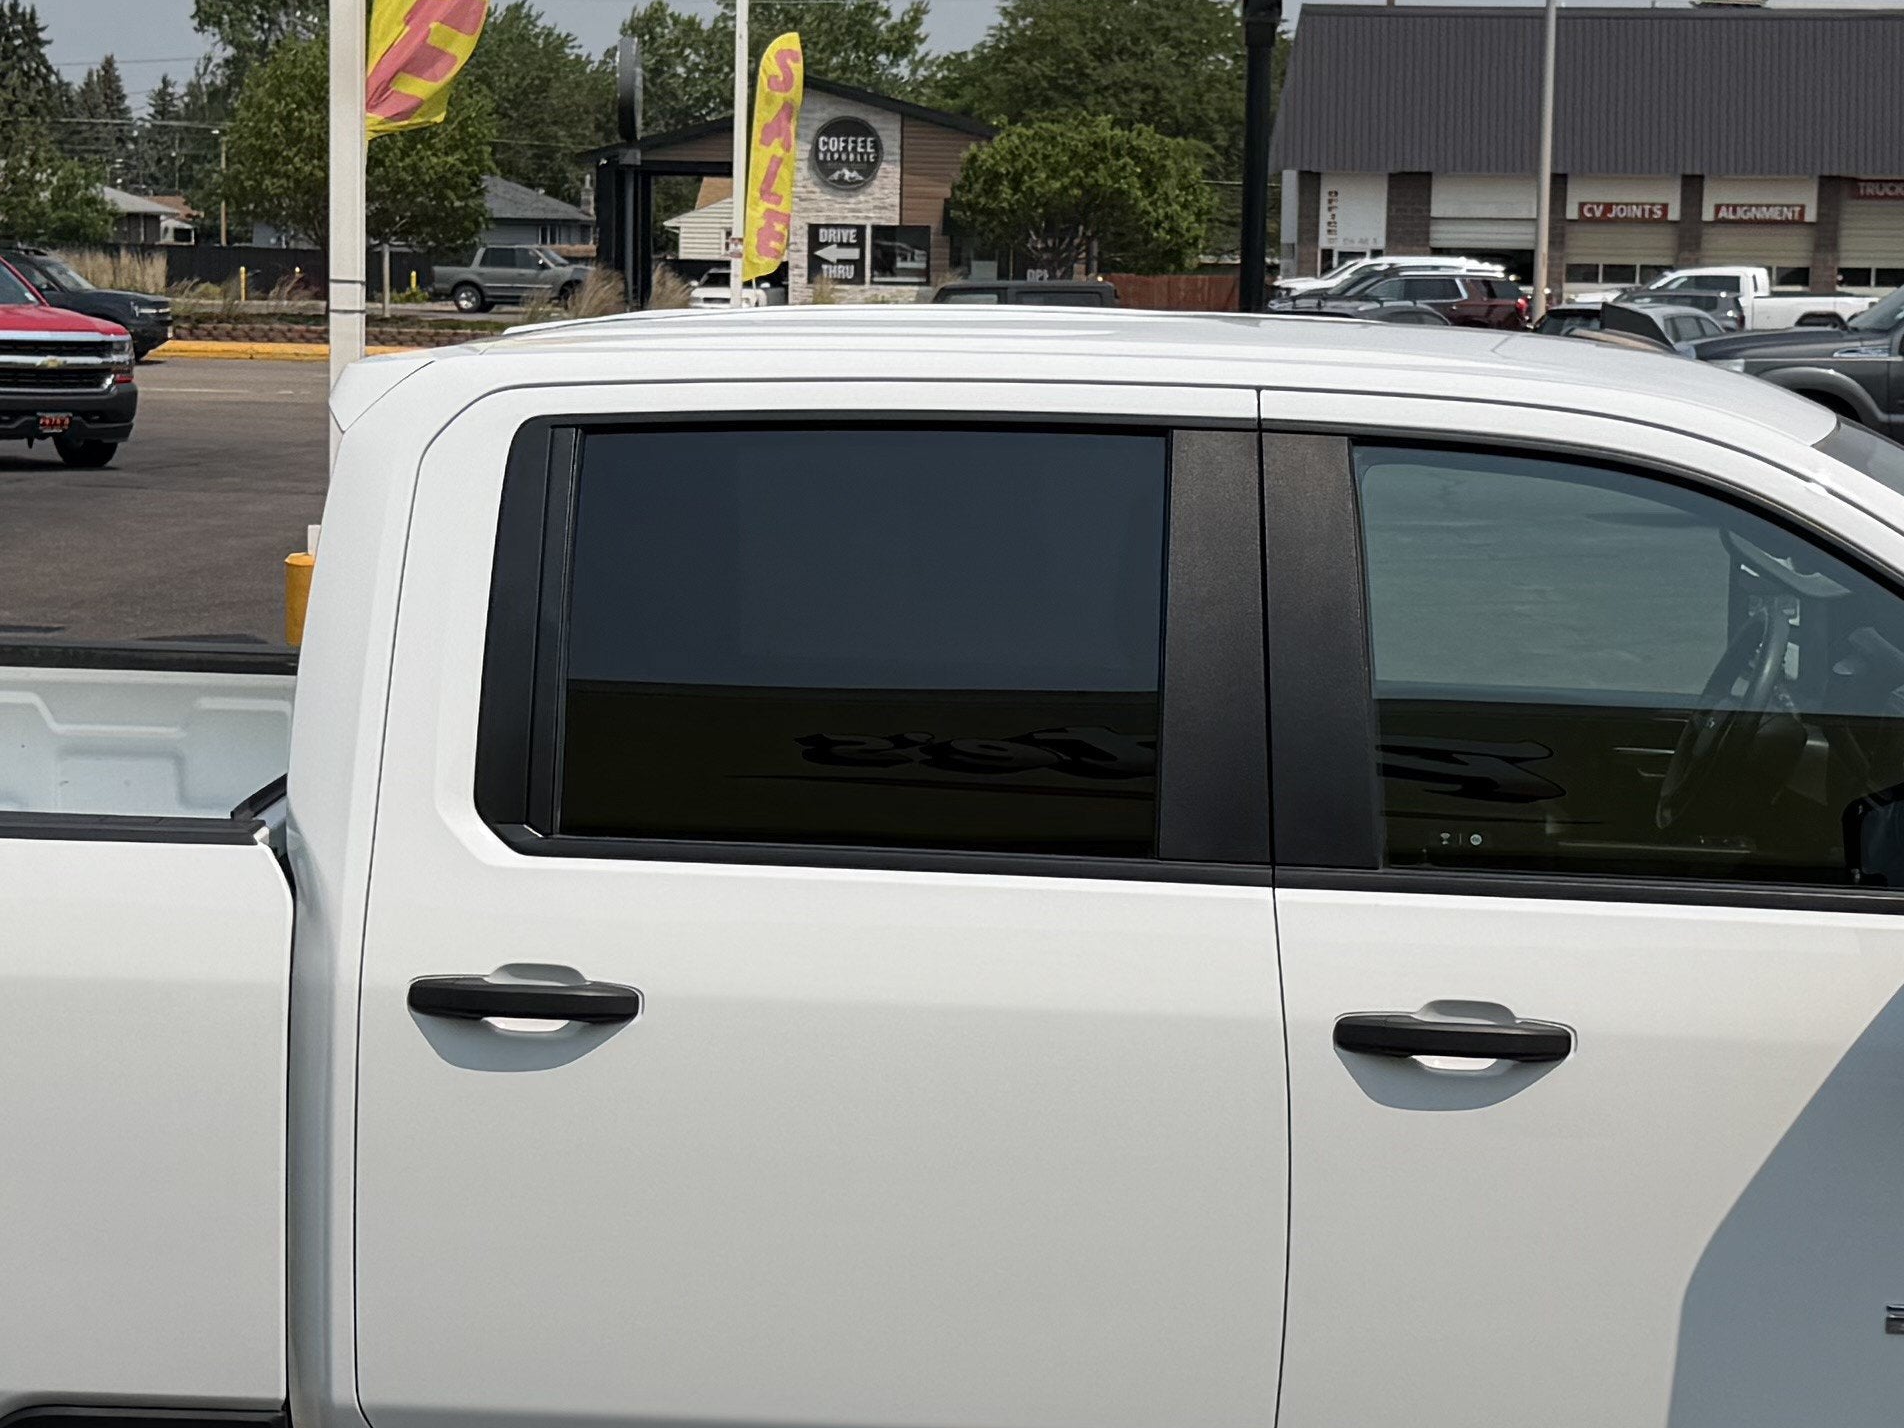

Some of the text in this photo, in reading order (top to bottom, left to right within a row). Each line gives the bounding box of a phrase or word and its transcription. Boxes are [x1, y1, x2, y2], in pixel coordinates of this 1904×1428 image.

[818, 136, 876, 152] COFFEE
[755, 49, 802, 260] SALE
[818, 152, 877, 162] REPUBLIC
[1857, 181, 1904, 196] TRUCK
[1582, 203, 1663, 219] CV JOINTS
[1717, 205, 1802, 221] ALIGNMENT
[818, 227, 857, 243] DRIVE
[821, 264, 855, 279] THRU
